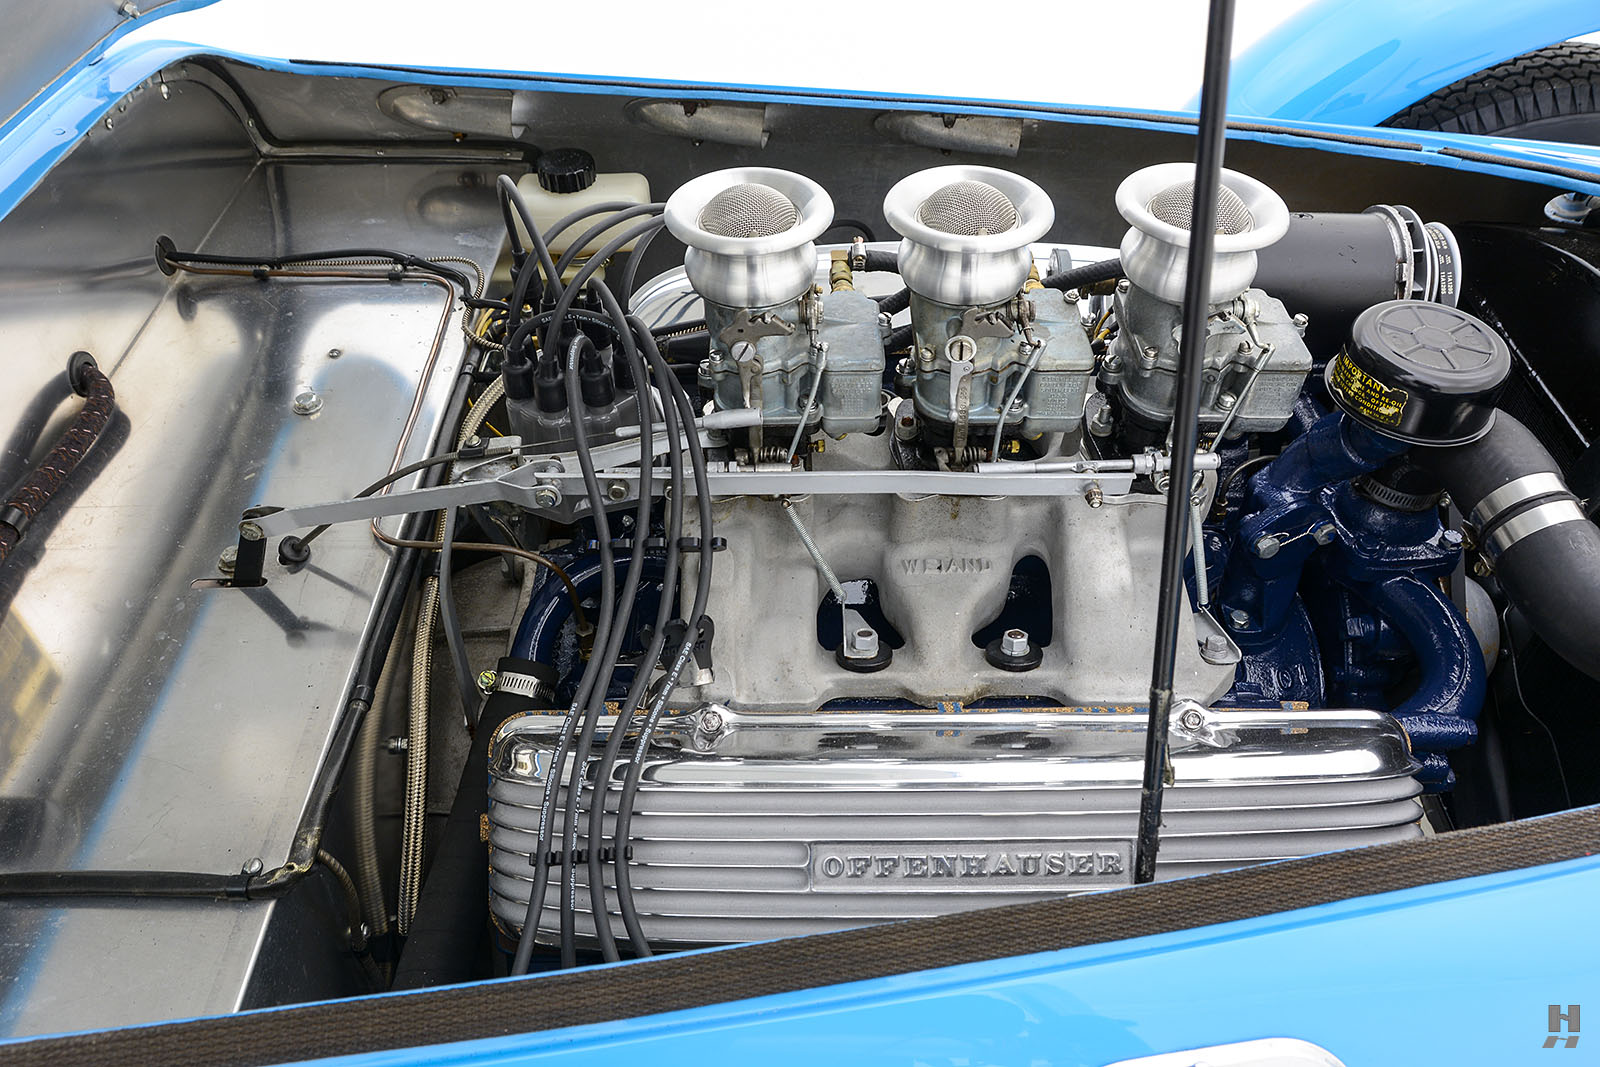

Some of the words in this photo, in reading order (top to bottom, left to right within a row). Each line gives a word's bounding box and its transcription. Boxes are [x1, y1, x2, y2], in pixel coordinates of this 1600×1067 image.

[682, 641, 692, 656] SAE
[674, 655, 686, 672] Class
[662, 681, 674, 696] 7mm
[649, 699, 664, 723] Silicone
[552, 746, 563, 763] 7mm
[634, 727, 651, 764] Suppressor
[545, 768, 556, 795] Silicone
[539, 801, 550, 841] Suppressor
[821, 851, 1125, 879] OFFENHAUSER
